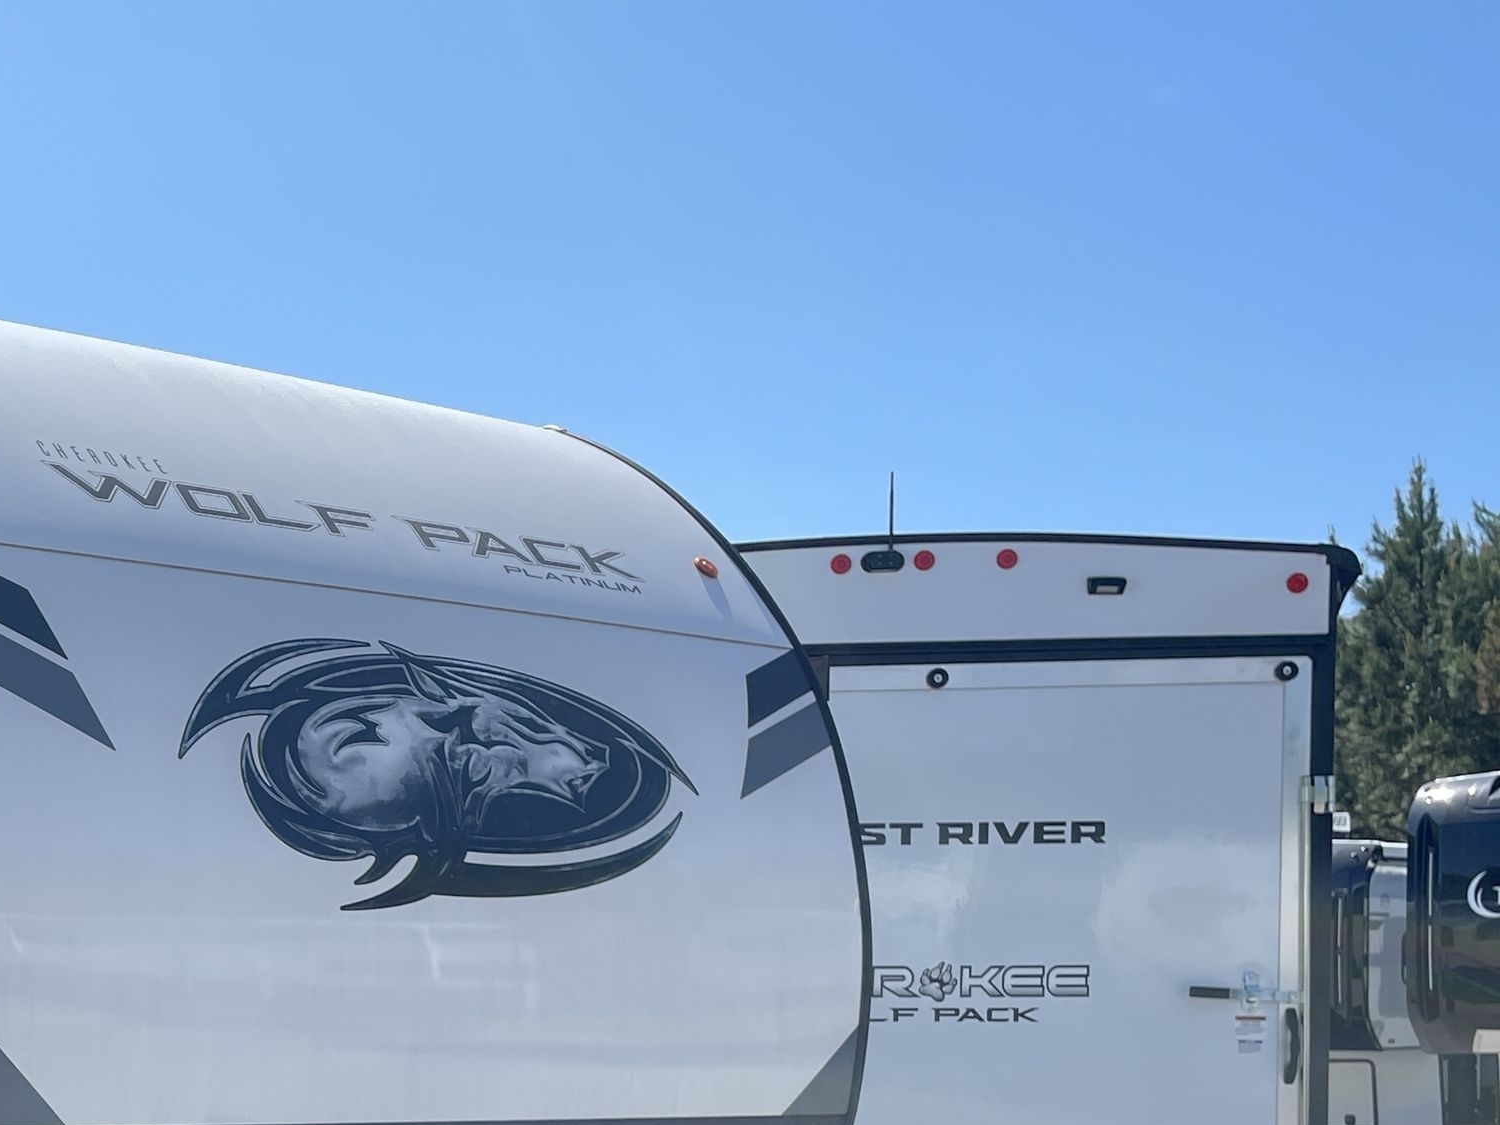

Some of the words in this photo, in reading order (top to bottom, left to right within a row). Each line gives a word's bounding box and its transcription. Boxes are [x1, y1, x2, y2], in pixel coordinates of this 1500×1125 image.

[35, 439, 169, 475] CHEROKEE
[40, 459, 376, 537] WOLF
[390, 514, 647, 583] PACK
[502, 564, 643, 595] PLATINUM
[936, 820, 1107, 845] RIVER
[931, 1006, 1040, 1023] PACK
